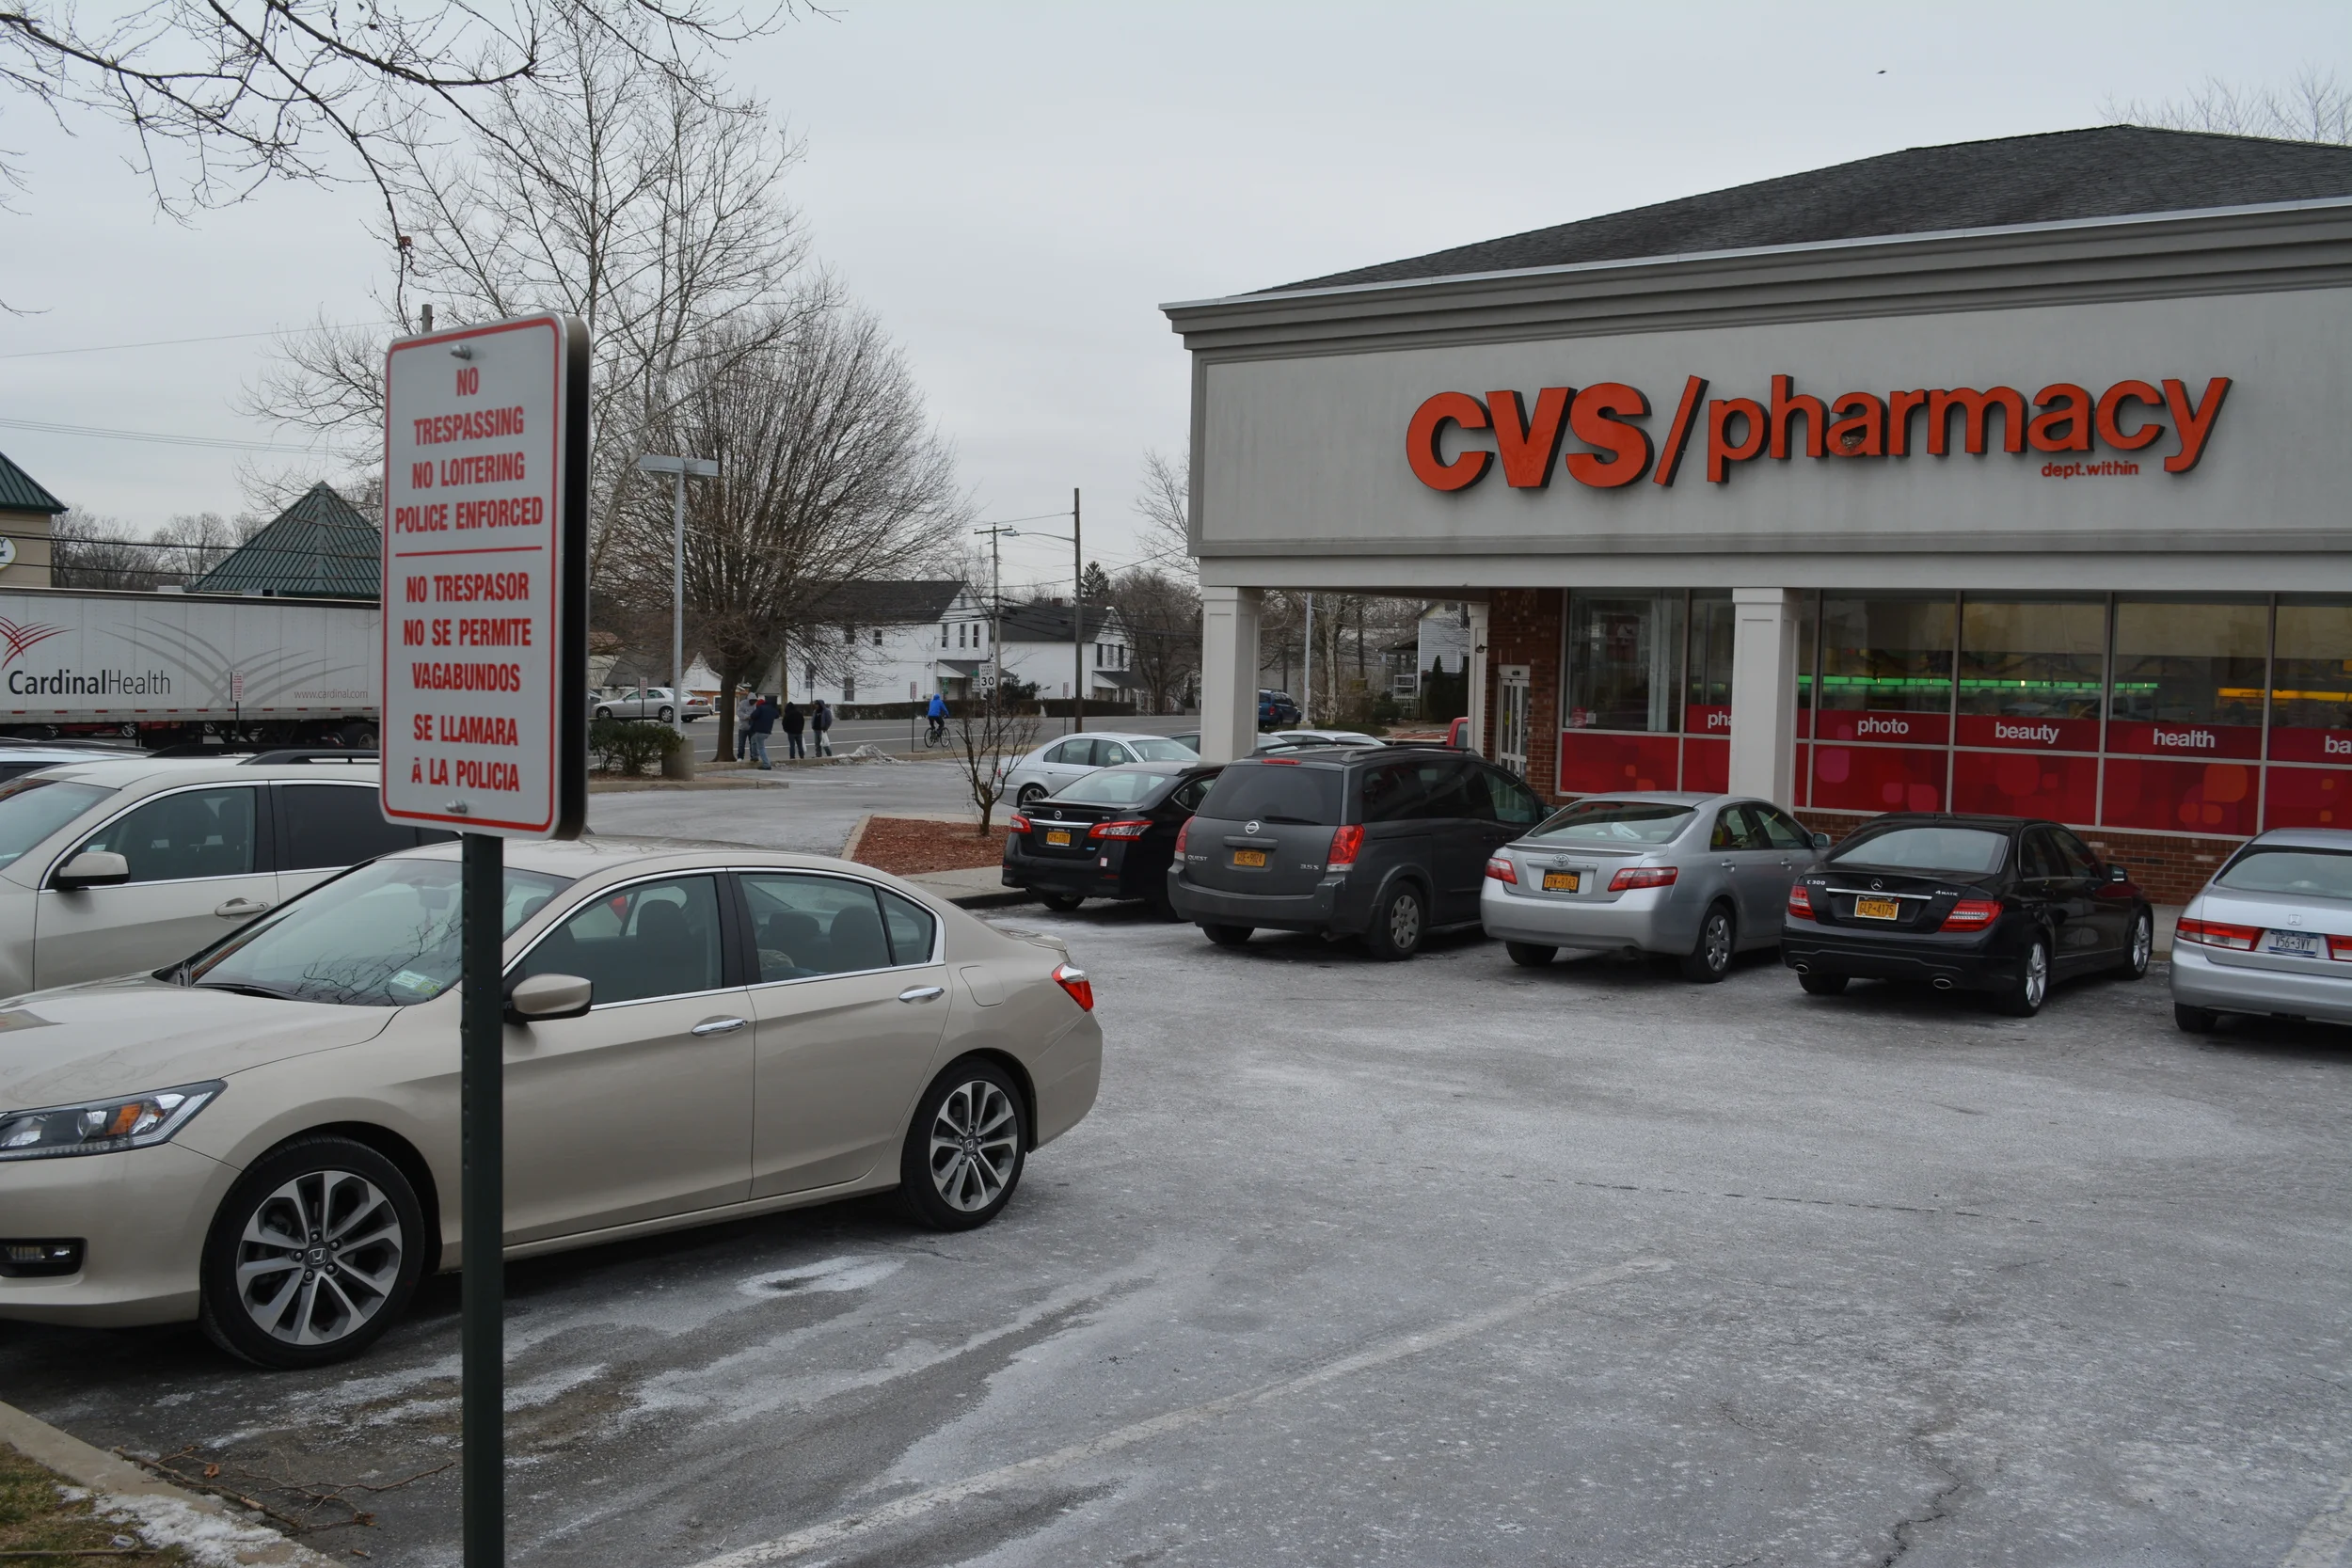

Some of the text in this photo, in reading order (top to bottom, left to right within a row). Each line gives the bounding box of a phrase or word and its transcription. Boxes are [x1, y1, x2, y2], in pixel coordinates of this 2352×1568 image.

[456, 367, 479, 396] NO
[414, 405, 524, 446] TRESPASSING
[1406, 374, 2233, 491] CVS/pharmacy
[412, 451, 525, 489] NO LOITERING
[395, 496, 544, 534] POLICE ENFORCED
[405, 572, 530, 603] NO TRESPASOR
[404, 617, 532, 648] NO SE PERMITE
[8, 669, 171, 695] CardinalHealth
[412, 662, 521, 693] VAGABUNDOS
[981, 676, 994, 687] 30
[294, 689, 368, 700] www.cardinal.com
[413, 714, 519, 747] SE LLAMARA
[1857, 717, 1910, 736] photo
[1994, 721, 2059, 745] beauty
[2153, 728, 2216, 749] health
[2324, 735, 2352, 754] ba
[429, 758, 450, 786] LA
[456, 759, 520, 792] POLICIA
